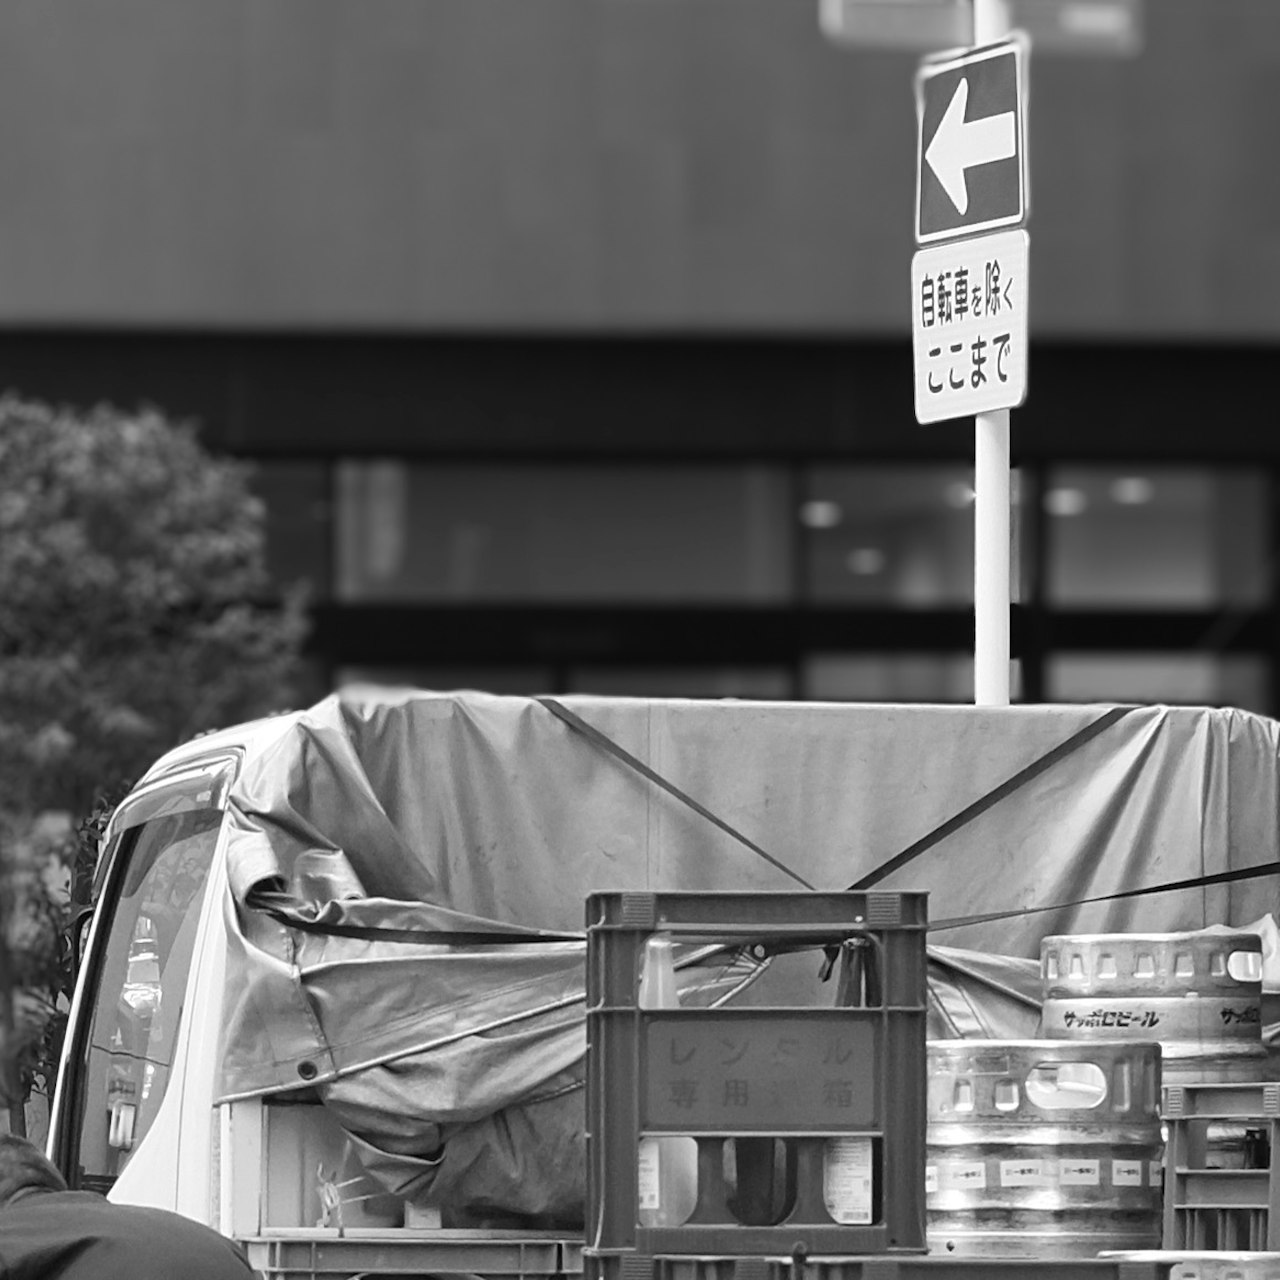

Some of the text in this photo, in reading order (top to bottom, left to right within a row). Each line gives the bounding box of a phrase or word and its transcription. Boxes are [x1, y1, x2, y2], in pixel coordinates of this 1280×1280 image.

[921, 259, 1014, 328] 自転車を除く
[928, 333, 1011, 394] ここまで
[667, 1078, 854, 1110] 専用箱
